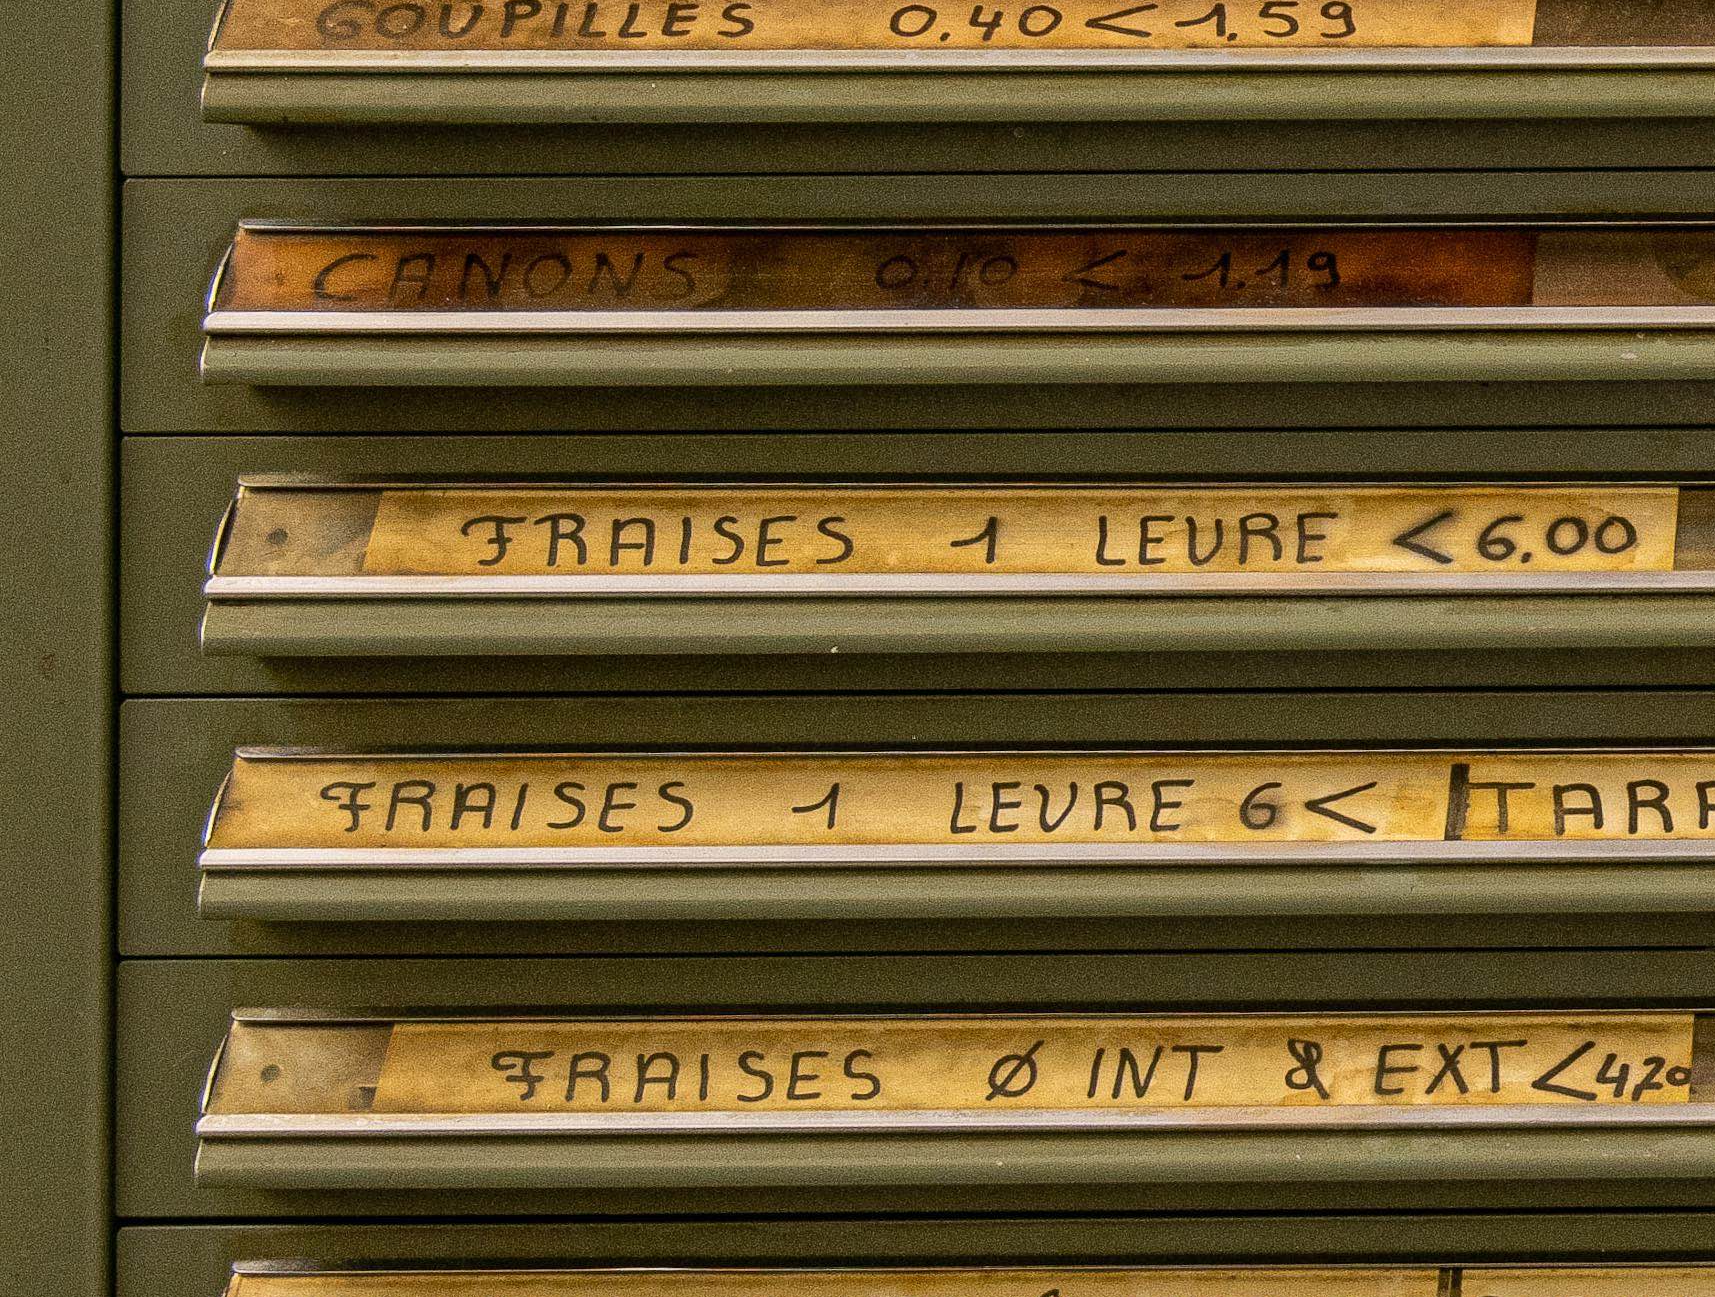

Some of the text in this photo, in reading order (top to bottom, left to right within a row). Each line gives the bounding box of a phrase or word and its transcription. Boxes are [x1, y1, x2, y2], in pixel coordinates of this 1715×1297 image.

[311, 251, 701, 302] CANONS
[459, 513, 855, 567] FRAISES
[951, 516, 1000, 564] 1
[1096, 510, 1339, 566] LEVRE
[319, 780, 694, 834] FRAISES
[792, 782, 841, 829] 1
[950, 779, 1195, 834] LEVRE
[490, 1049, 882, 1102] FRAISES
[1087, 1044, 1223, 1101] INT
[1373, 1039, 1529, 1097] EXT
